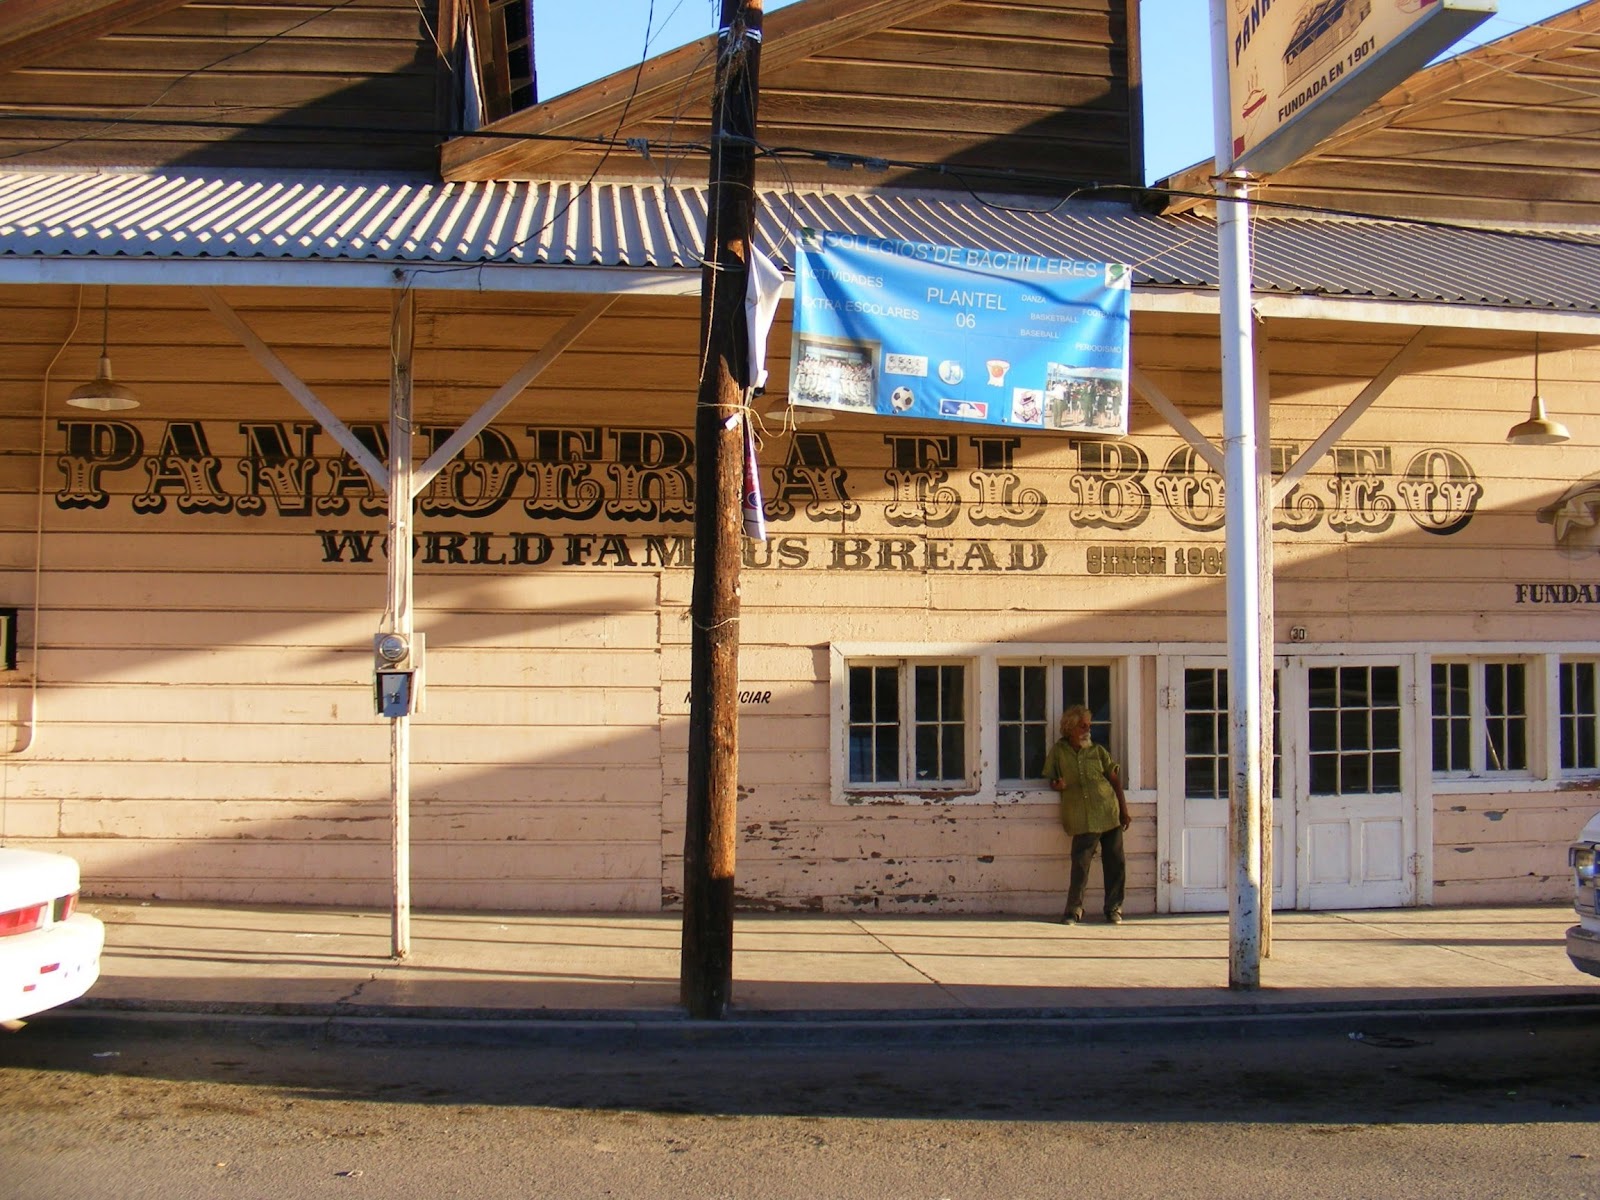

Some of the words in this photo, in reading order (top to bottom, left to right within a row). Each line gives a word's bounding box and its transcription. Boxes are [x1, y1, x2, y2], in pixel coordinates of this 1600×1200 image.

[1278, 77, 1328, 123] FUNDADA
[1329, 63, 1344, 82] EN
[1347, 35, 1376, 68] 1901
[825, 232, 928, 259] COLEGIOS
[934, 246, 961, 266] DE
[966, 250, 1098, 278] BACHILLERES
[927, 287, 1007, 311] PLANTEL
[1021, 294, 1047, 304] DANZA
[845, 300, 920, 321] ESCOLARES
[956, 313, 977, 329] 06
[1030, 313, 1079, 323] BASKETBALL
[1020, 329, 1060, 338] BASEBALL
[1075, 342, 1122, 353] PERIODISMO
[56, 420, 861, 523] PANADERA
[883, 433, 1048, 528] EL
[562, 532, 809, 569] FAMUS
[827, 537, 1048, 573] BREAD
[1086, 546, 1167, 574] SINCE
[1292, 628, 1305, 640] 30
